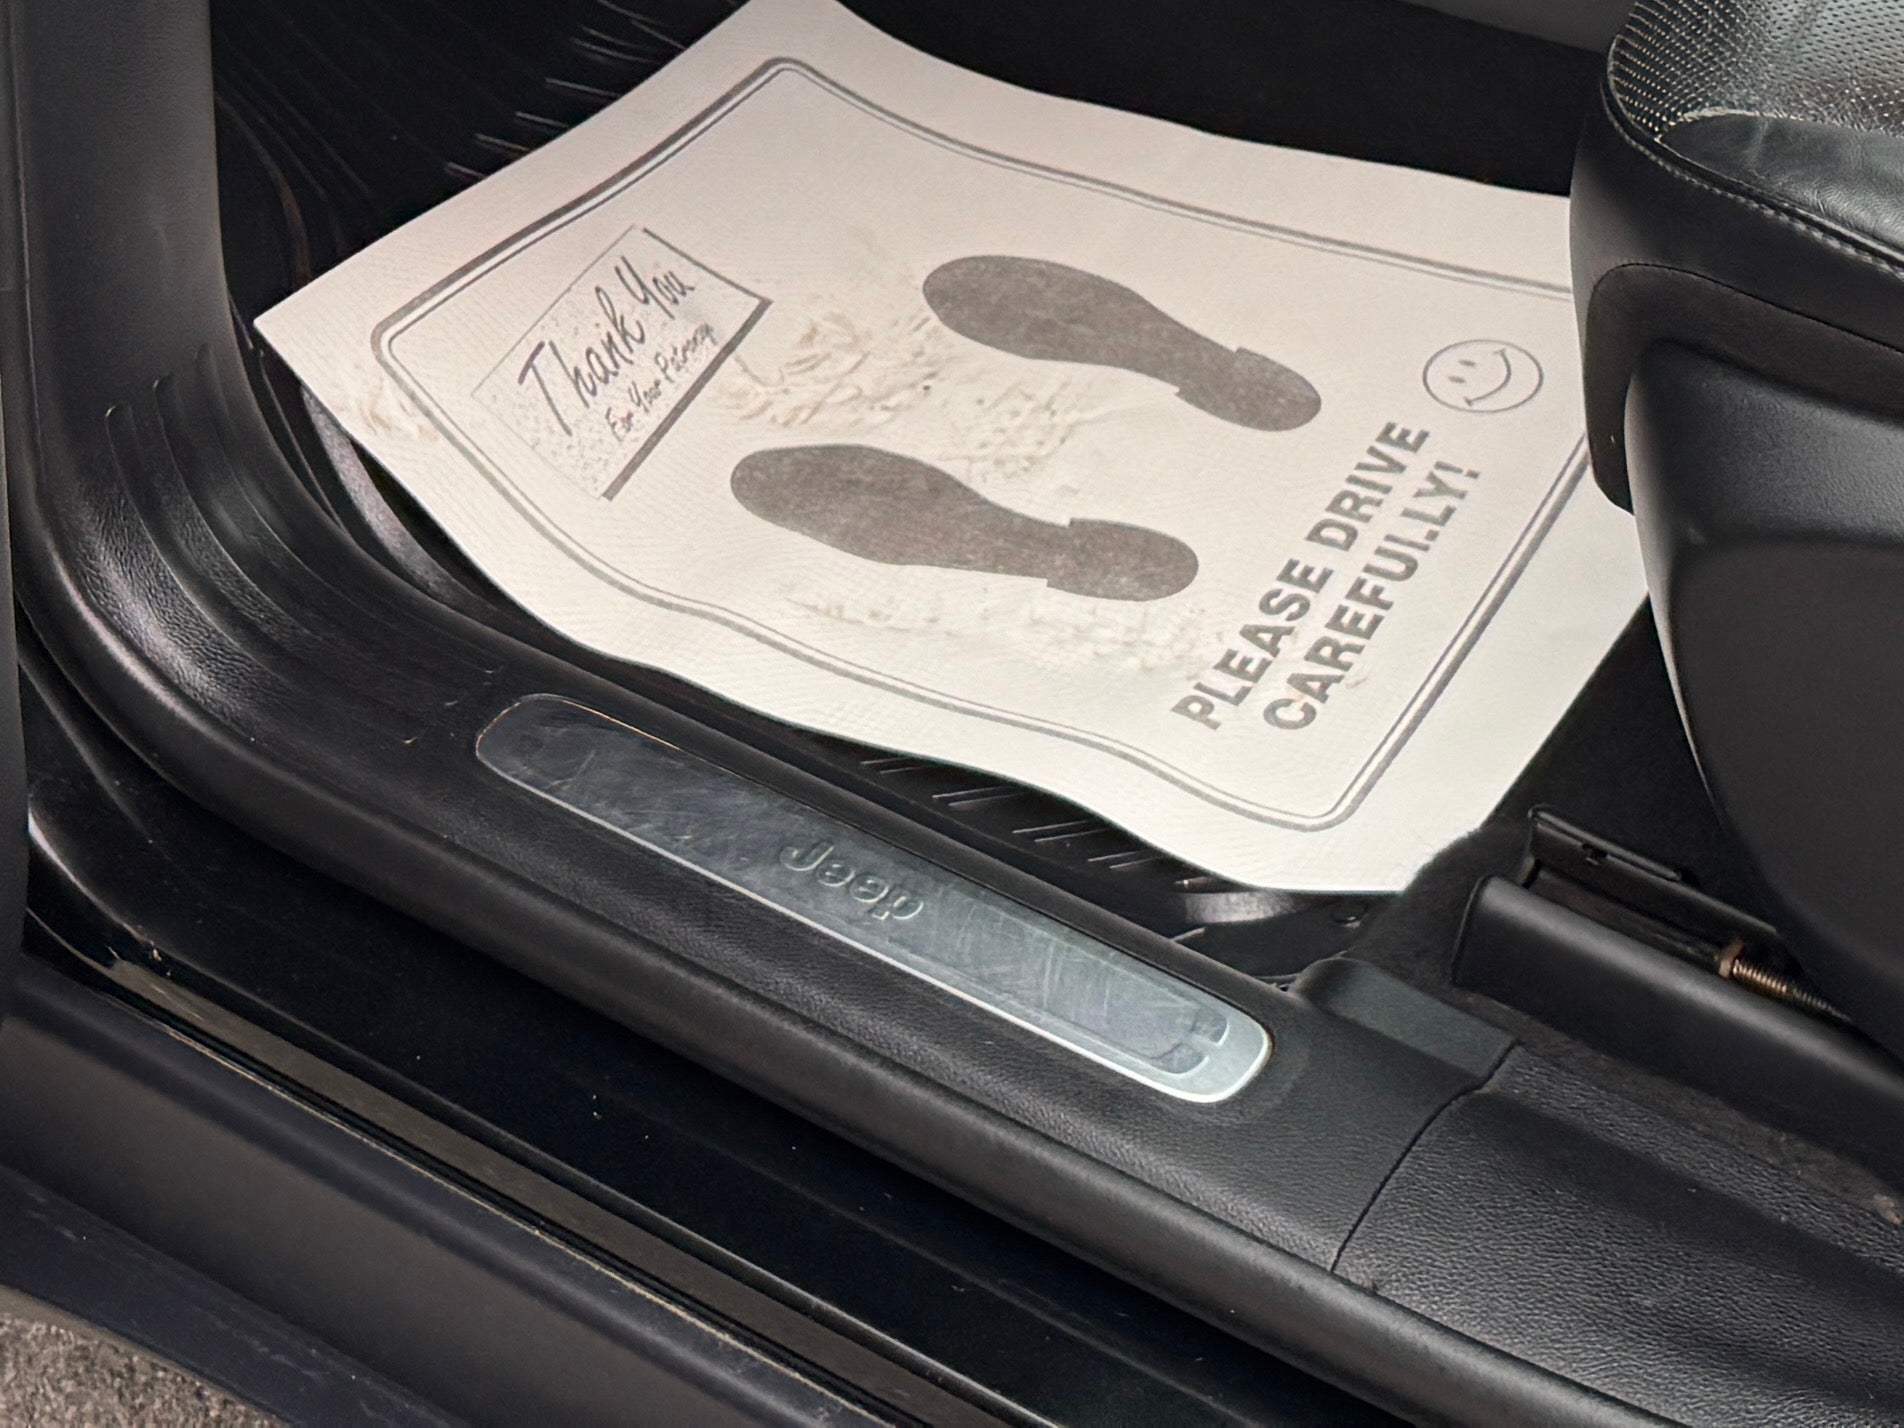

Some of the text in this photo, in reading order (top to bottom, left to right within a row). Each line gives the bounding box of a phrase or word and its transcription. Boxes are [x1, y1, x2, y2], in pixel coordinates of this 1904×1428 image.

[517, 255, 696, 437] Thank You
[1169, 421, 1431, 732] PLEASE DRIVE
[1261, 459, 1482, 732] CAREFULLY!
[778, 839, 925, 922] Jeep
